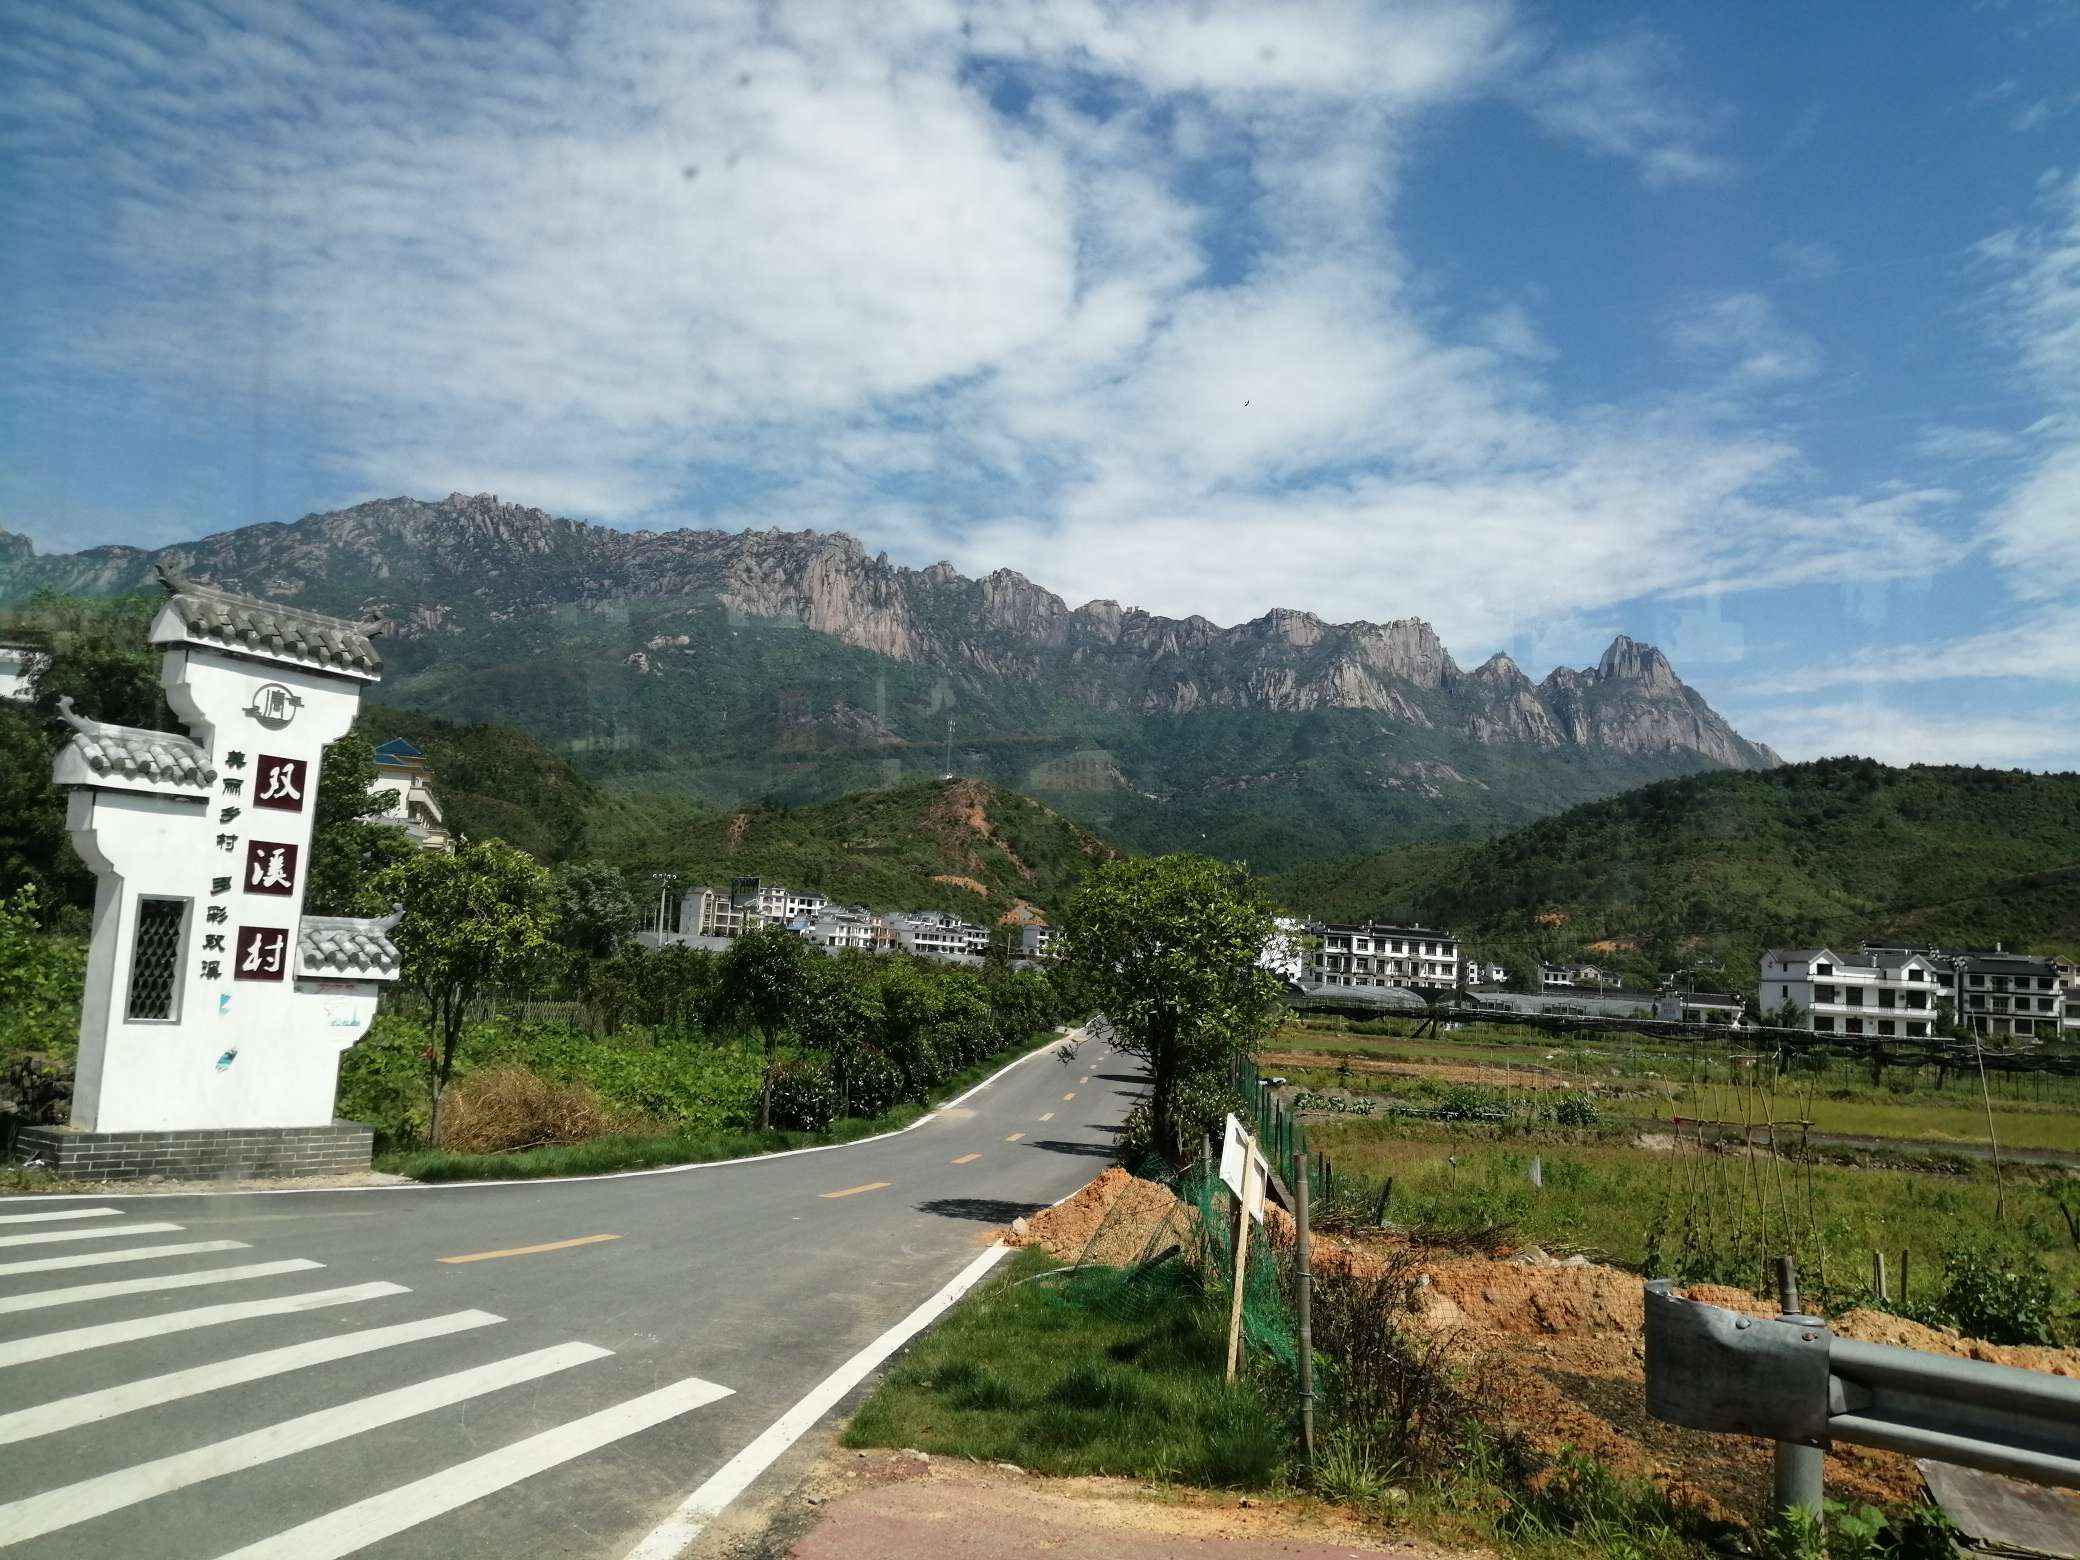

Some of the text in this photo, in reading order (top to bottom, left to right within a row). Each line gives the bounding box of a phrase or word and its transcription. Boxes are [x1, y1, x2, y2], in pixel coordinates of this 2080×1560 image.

[216, 750, 247, 853] 美丽乡村
[242, 762, 301, 973] 双溪村
